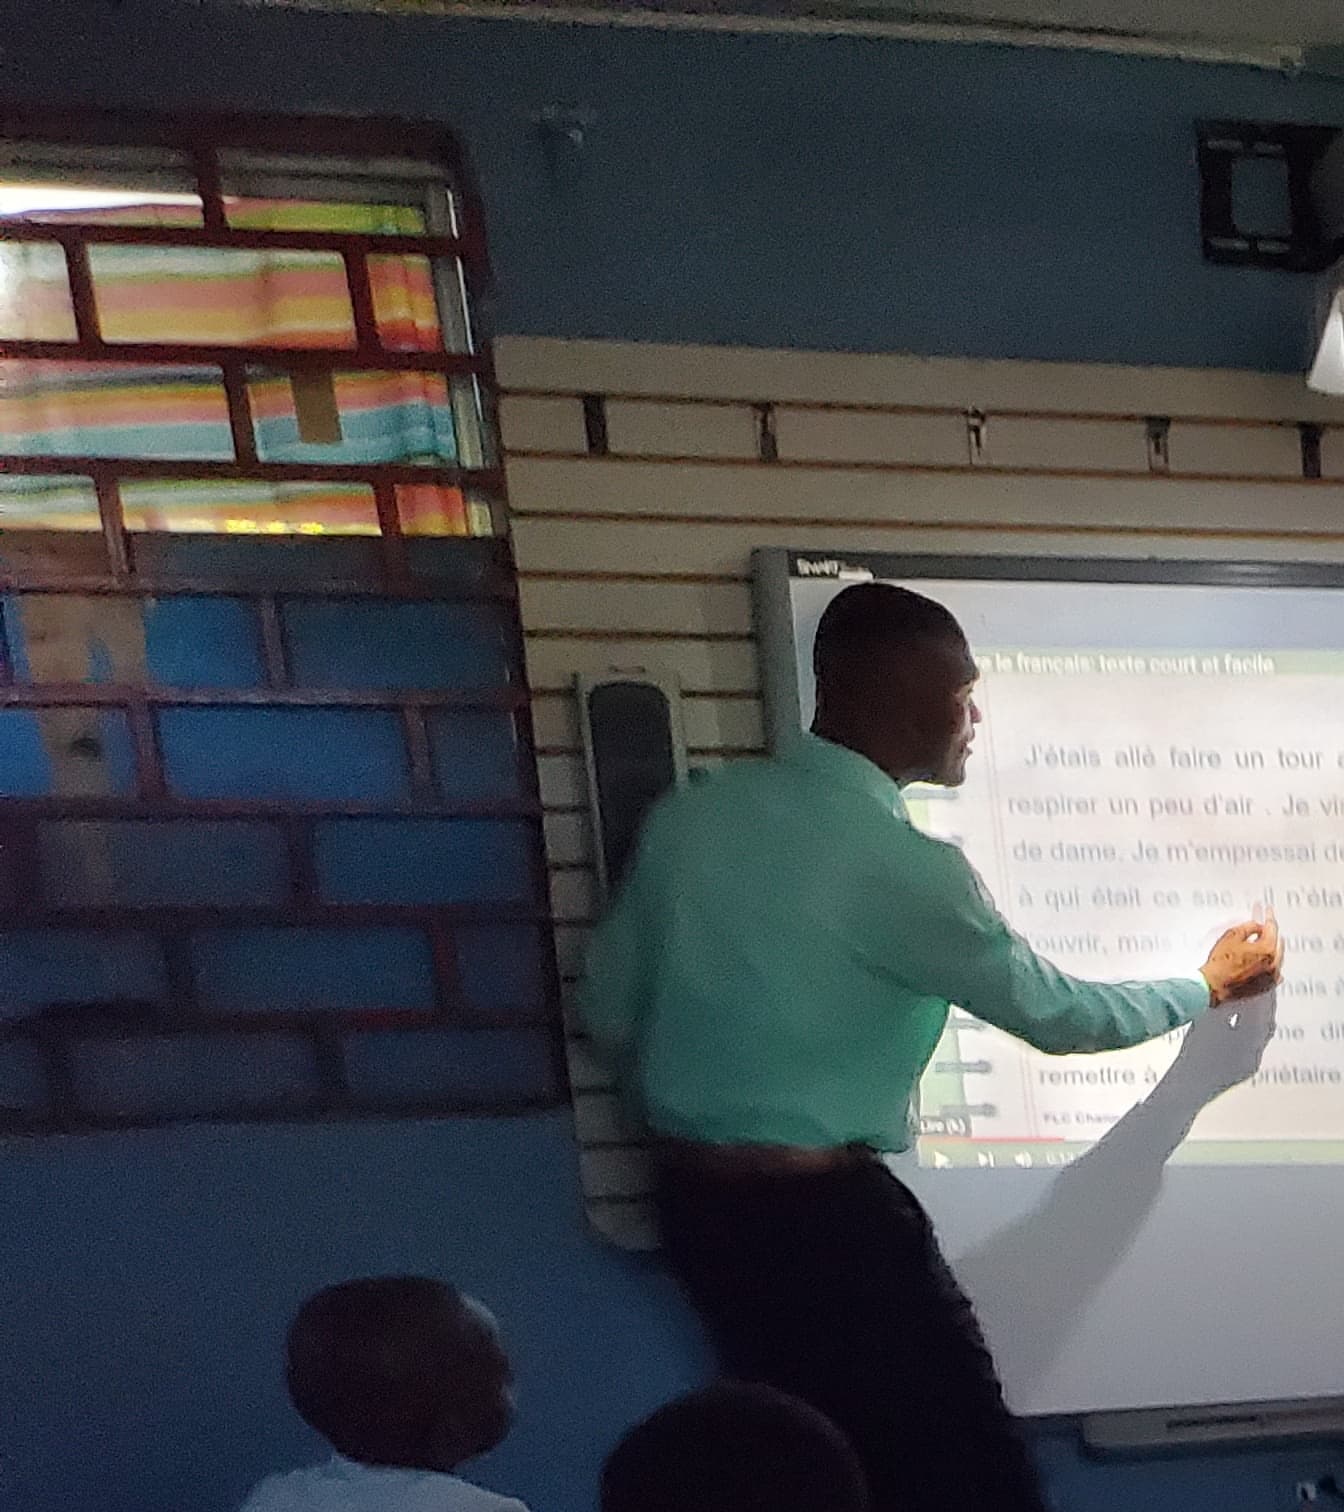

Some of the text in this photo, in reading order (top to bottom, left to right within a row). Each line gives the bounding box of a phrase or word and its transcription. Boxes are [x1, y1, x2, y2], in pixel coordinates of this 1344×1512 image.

[995, 651, 1013, 673] le
[1100, 652, 1146, 674] texte
[1149, 653, 1196, 674] court
[1201, 654, 1220, 674] et
[1224, 653, 1275, 674] facile
[1023, 745, 1101, 769] J'étais
[1114, 745, 1156, 769] allé
[1169, 746, 1221, 769] faire
[1234, 751, 1265, 769] un
[1277, 746, 1323, 769] tour
[1008, 795, 1098, 821] respirer
[1110, 798, 1138, 816] un
[1149, 798, 1193, 821] peu
[1203, 794, 1254, 816] d'air
[1281, 795, 1310, 816] Je
[1013, 840, 1043, 863] de
[1132, 840, 1159, 863] Je
[1166, 841, 1317, 868] m'empressai
[1018, 886, 1034, 907] à
[1044, 887, 1080, 911] qui
[1091, 886, 1142, 907] était
[1152, 890, 1182, 907] ce
[1192, 890, 1233, 907] sac
[1039, 1064, 1135, 1085] remettre
[1144, 1064, 1158, 1085] à
